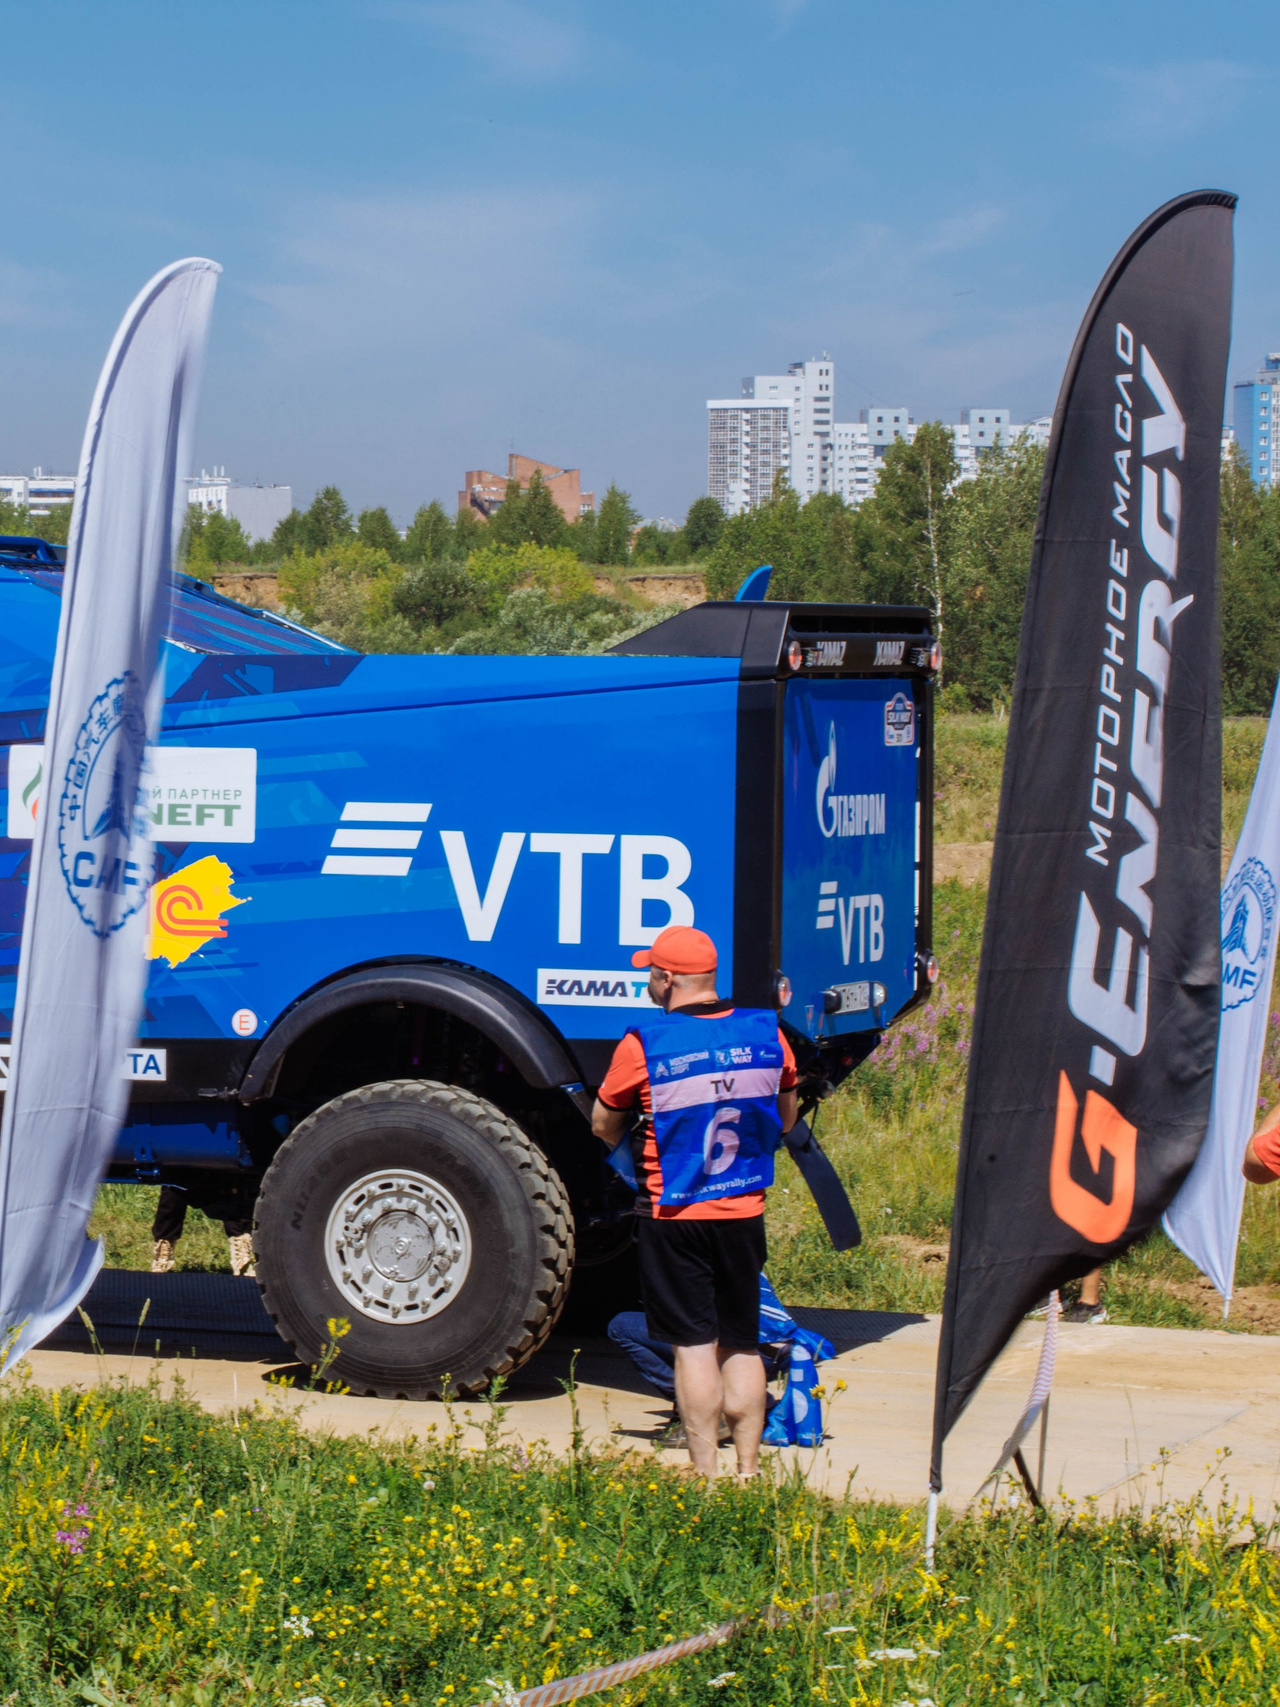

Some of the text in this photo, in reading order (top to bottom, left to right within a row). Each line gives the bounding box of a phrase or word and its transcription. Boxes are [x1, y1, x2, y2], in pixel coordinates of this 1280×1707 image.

[1085, 323, 1135, 867] МОТОРНОЕ МАСЛО
[168, 788, 242, 800] ПАРТНЕР
[148, 803, 242, 827] NEFT
[439, 830, 695, 947] VTB
[838, 893, 885, 966] VTB
[545, 978, 650, 998] KAMA T
[730, 1046, 752, 1057] SILK
[731, 1055, 752, 1065] WAY
[126, 1053, 162, 1075] TA
[710, 1078, 735, 1095] TV
[703, 1107, 741, 1176] 6
